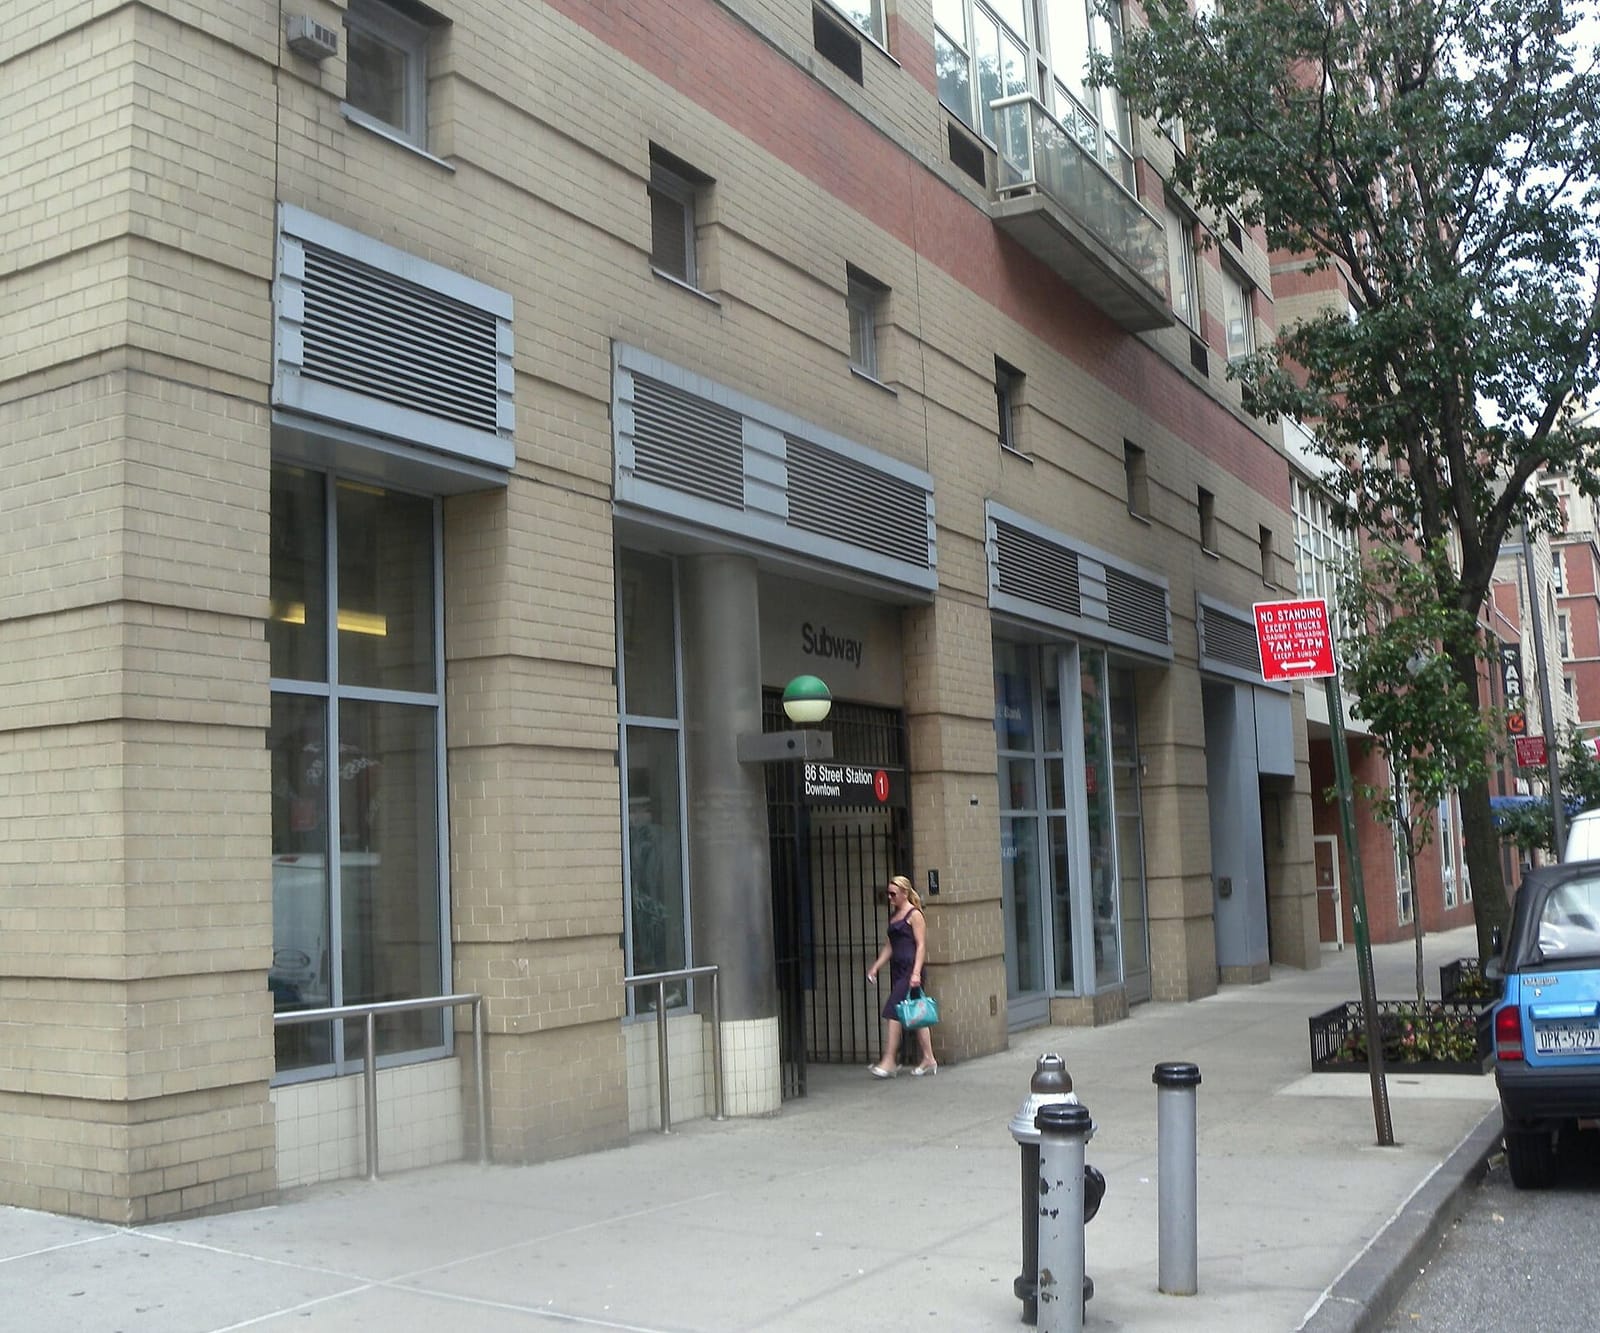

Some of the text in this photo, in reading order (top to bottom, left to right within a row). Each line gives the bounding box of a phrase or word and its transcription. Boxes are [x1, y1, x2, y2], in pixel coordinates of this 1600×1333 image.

[1260, 608, 1321, 623] NO STANDING
[1265, 621, 1321, 633] EXCEPT TRUCKS
[802, 623, 862, 666] Subway
[804, 764, 884, 795] 86 Street Station 1
[805, 781, 840, 796] Downtown
